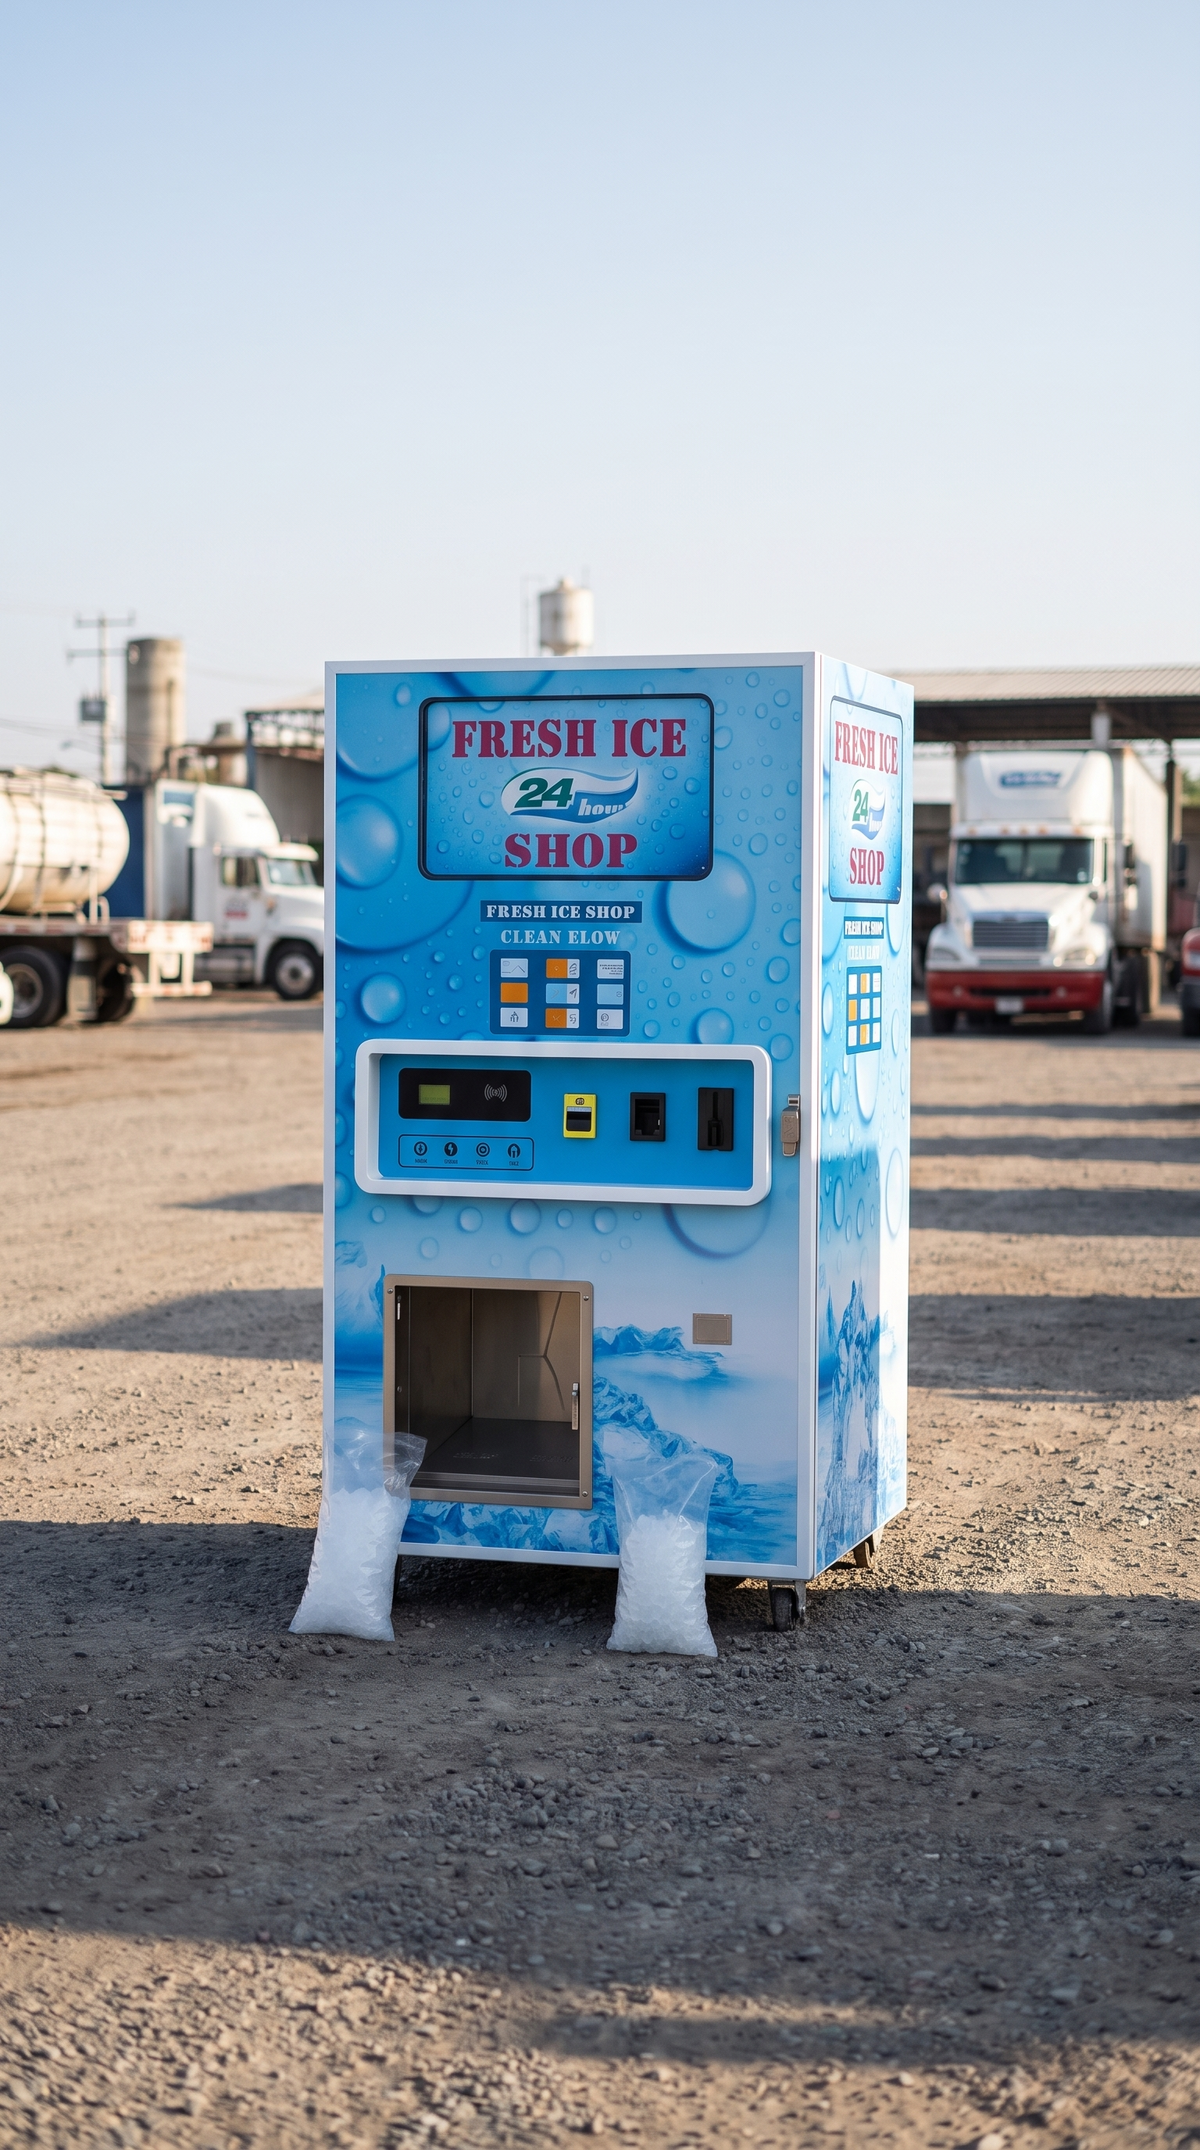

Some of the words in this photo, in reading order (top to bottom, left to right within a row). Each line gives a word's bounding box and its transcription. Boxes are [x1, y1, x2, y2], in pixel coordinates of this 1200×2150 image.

[452, 719, 597, 758] FRESH
[612, 718, 687, 757] ICE
[835, 720, 876, 770] FRESH
[878, 732, 898, 775] ICE
[514, 777, 574, 808] 24
[852, 789, 869, 823] 24
[504, 833, 638, 868] SHOP
[850, 847, 885, 886] SHOP
[486, 905, 546, 918] FRESH
[551, 905, 581, 919] ICE
[585, 905, 635, 919] SHOP
[501, 930, 562, 944] CLEAN
